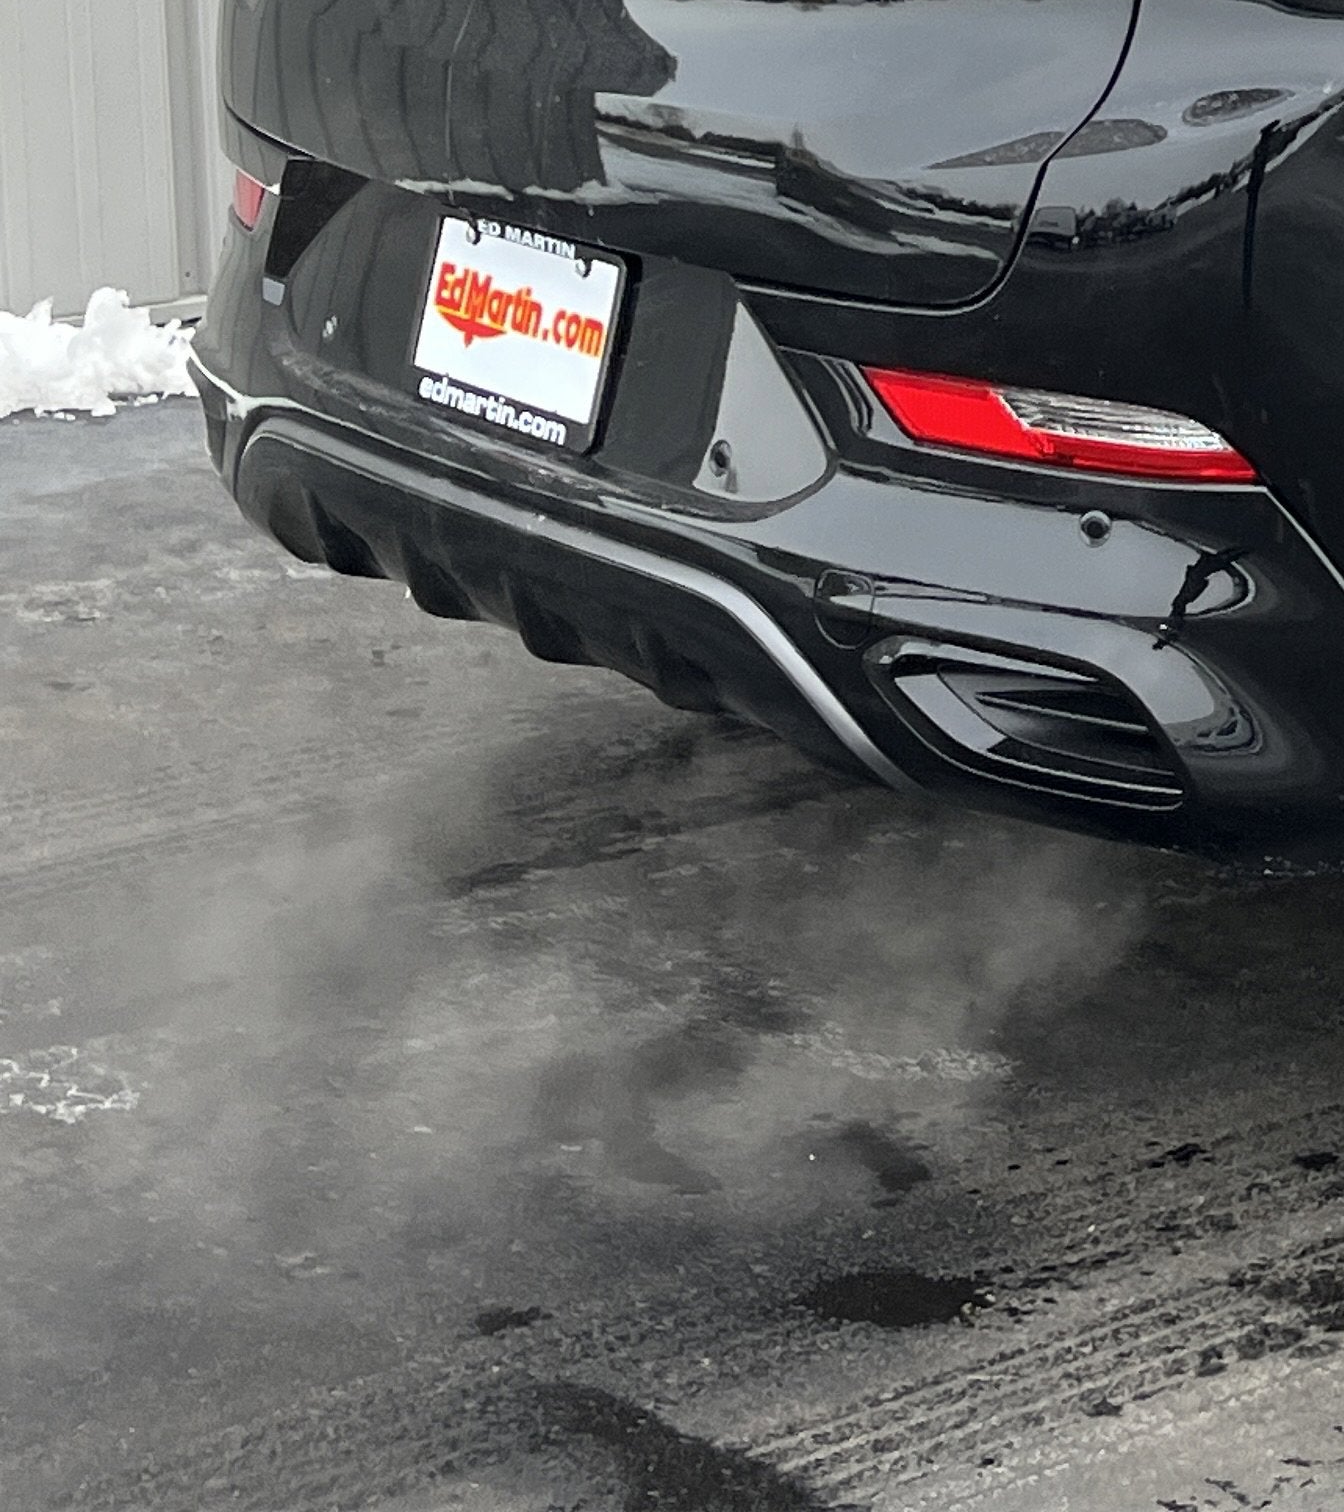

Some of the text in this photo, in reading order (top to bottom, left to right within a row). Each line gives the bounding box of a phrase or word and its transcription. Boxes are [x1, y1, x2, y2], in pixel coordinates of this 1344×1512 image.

[477, 218, 576, 260] ED MARTIN
[434, 261, 604, 357] EdMartin.com
[418, 376, 567, 445] edmartin.com
